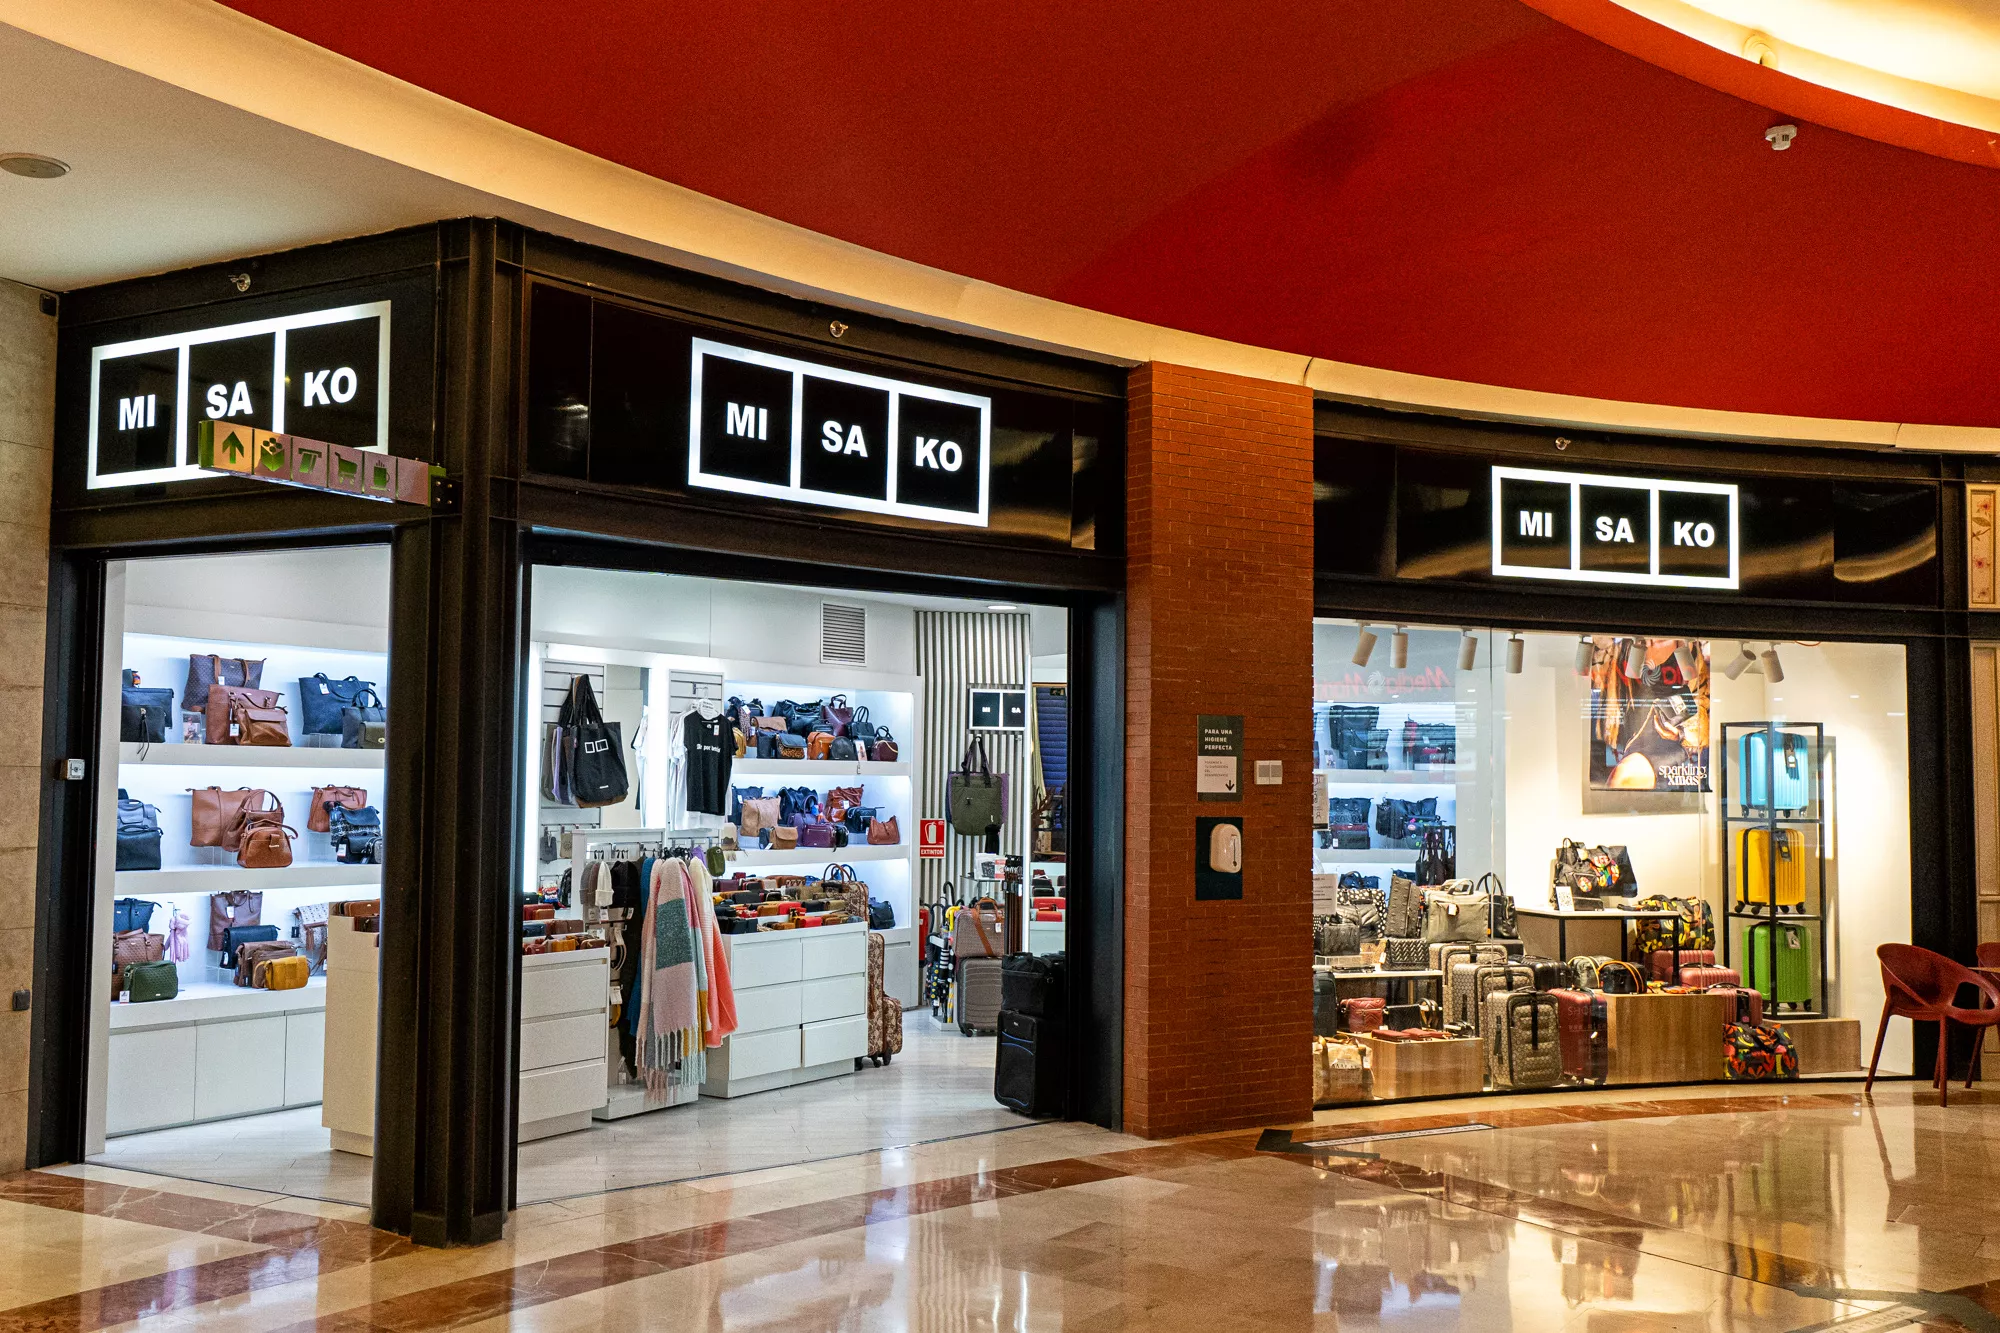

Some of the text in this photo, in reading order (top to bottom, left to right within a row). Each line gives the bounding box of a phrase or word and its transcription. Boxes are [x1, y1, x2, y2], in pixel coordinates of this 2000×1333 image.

[119, 366, 357, 430] MI SA KO
[726, 402, 963, 472] MI SA KO
[1519, 510, 1716, 548] MI SA KO
[1658, 763, 1708, 779] sparkling
[1667, 774, 1699, 786] xmas
